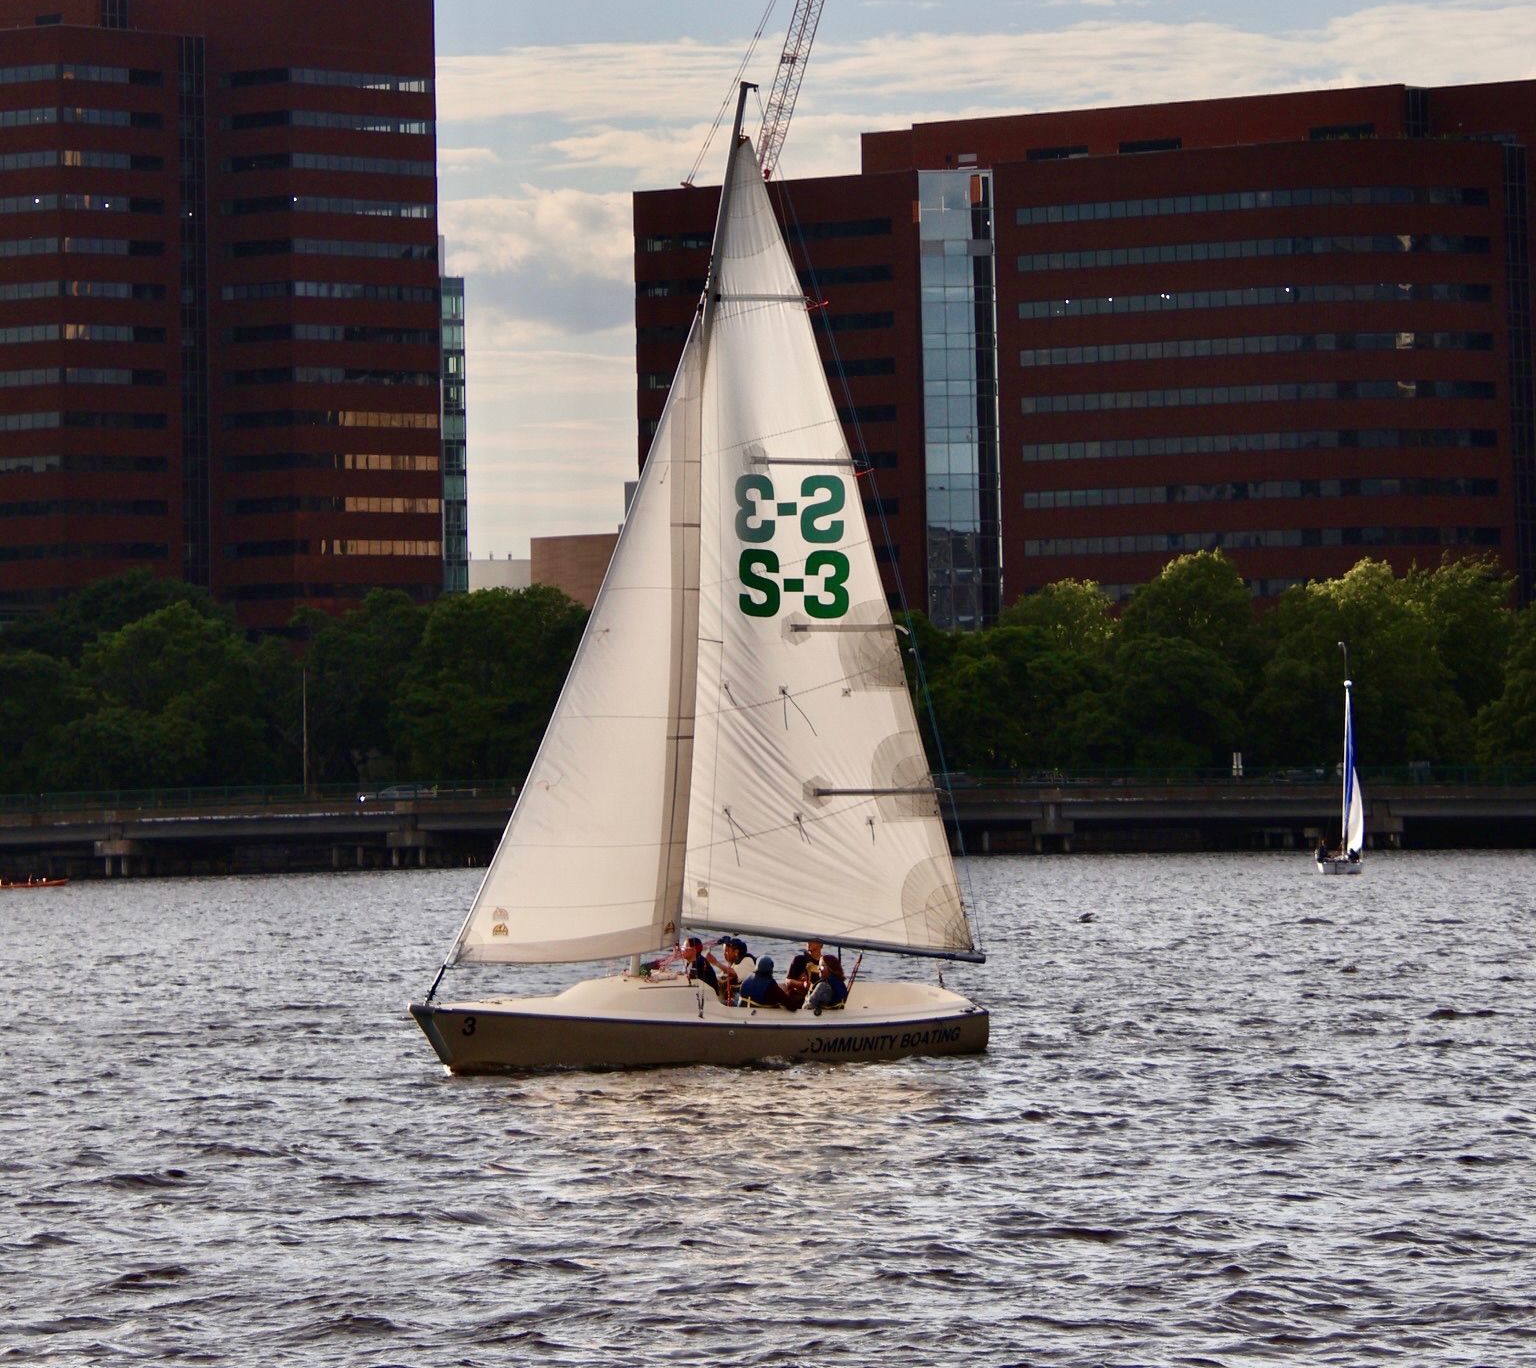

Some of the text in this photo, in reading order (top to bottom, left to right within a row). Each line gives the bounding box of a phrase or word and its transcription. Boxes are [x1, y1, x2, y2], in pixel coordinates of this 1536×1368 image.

[739, 548, 850, 619] S-3
[462, 1016, 477, 1036] 3
[900, 1026, 961, 1048] BOATING
